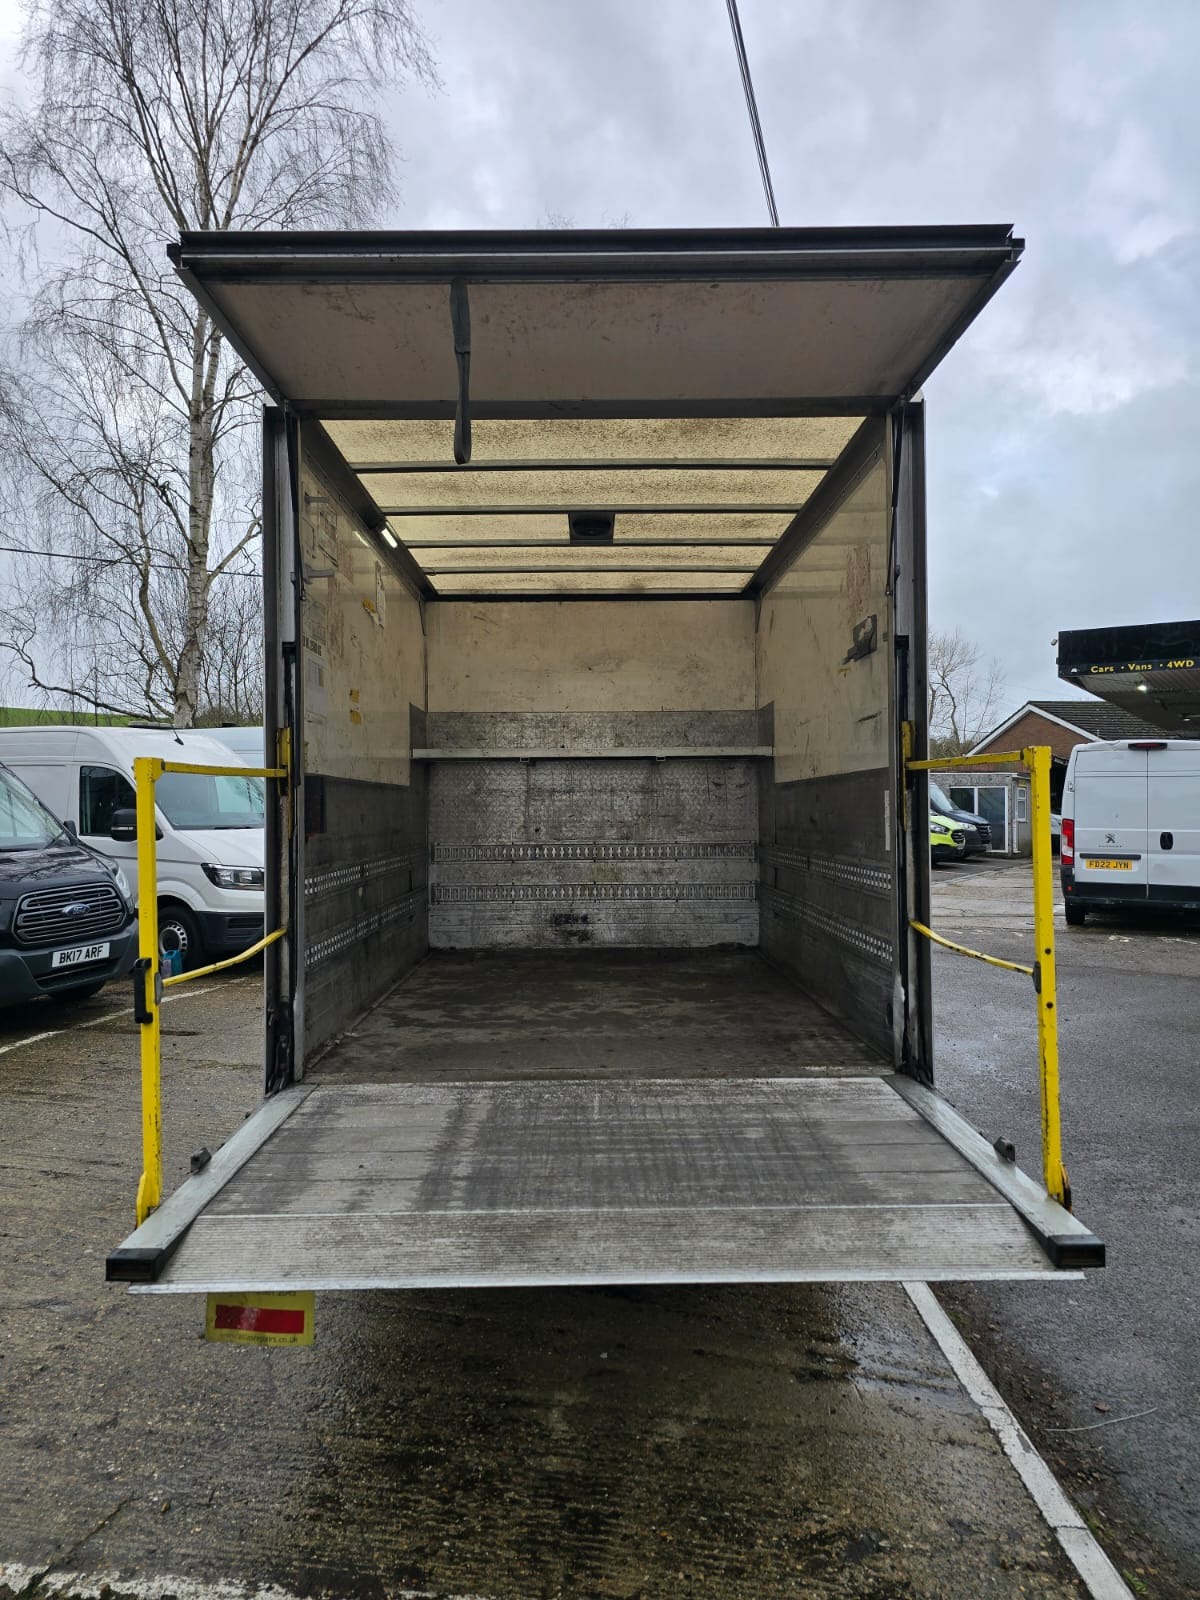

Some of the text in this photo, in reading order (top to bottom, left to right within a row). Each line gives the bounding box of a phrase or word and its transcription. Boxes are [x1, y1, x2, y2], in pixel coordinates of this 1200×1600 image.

[1090, 660, 1194, 673] Cars Vans 4WD
[1113, 861, 1129, 869] JYN
[59, 945, 103, 964] BK17 ARF
